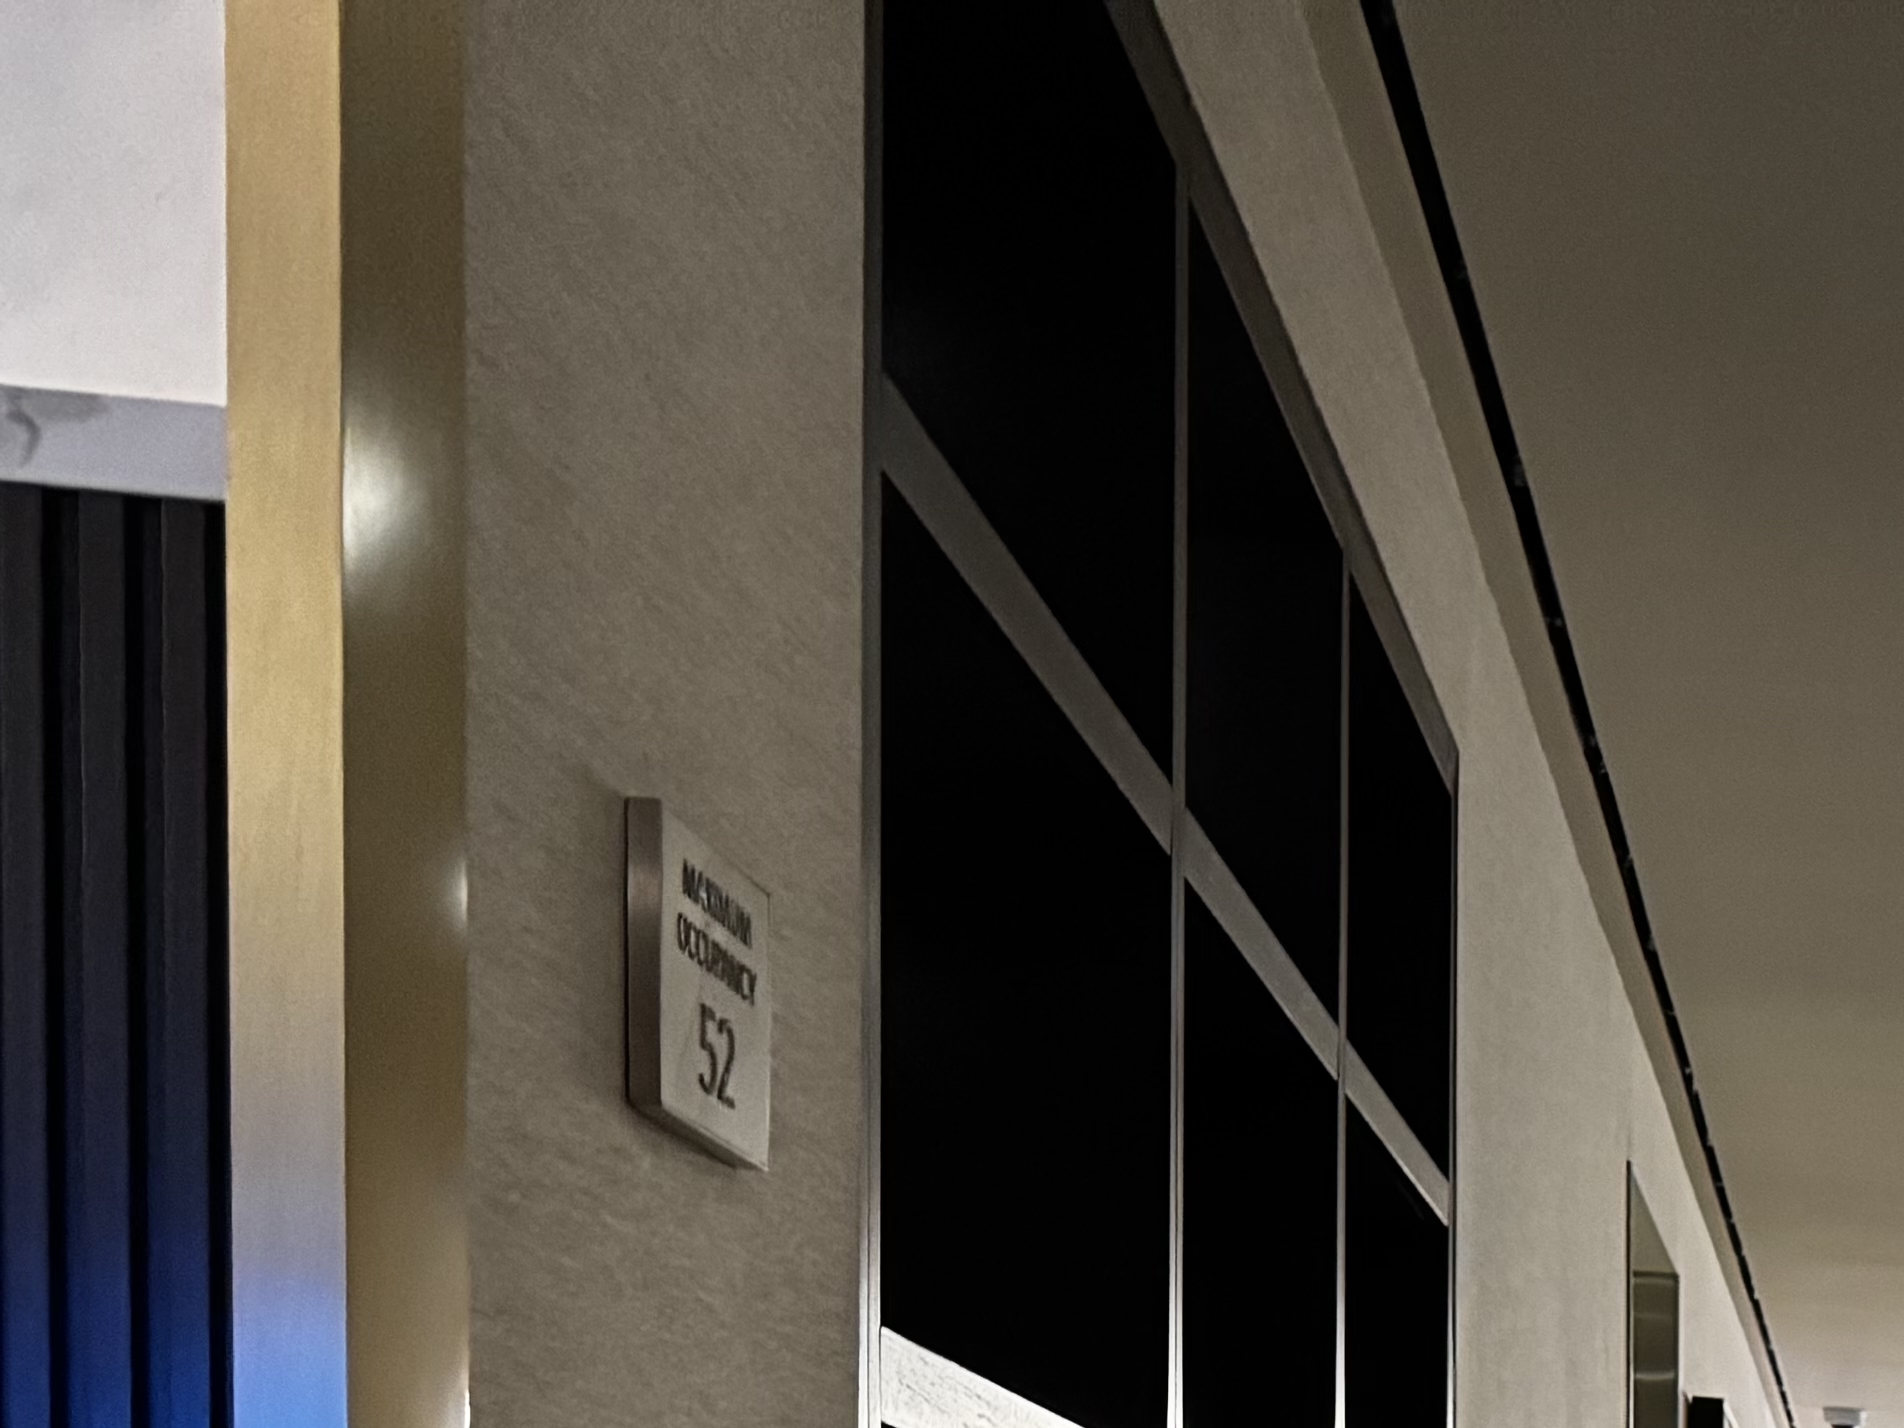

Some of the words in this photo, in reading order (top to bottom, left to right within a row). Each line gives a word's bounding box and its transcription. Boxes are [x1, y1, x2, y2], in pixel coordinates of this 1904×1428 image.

[682, 858, 752, 949] MAXIMUM
[677, 911, 757, 1006] OCCUPANCY
[698, 1002, 736, 1110] 52
